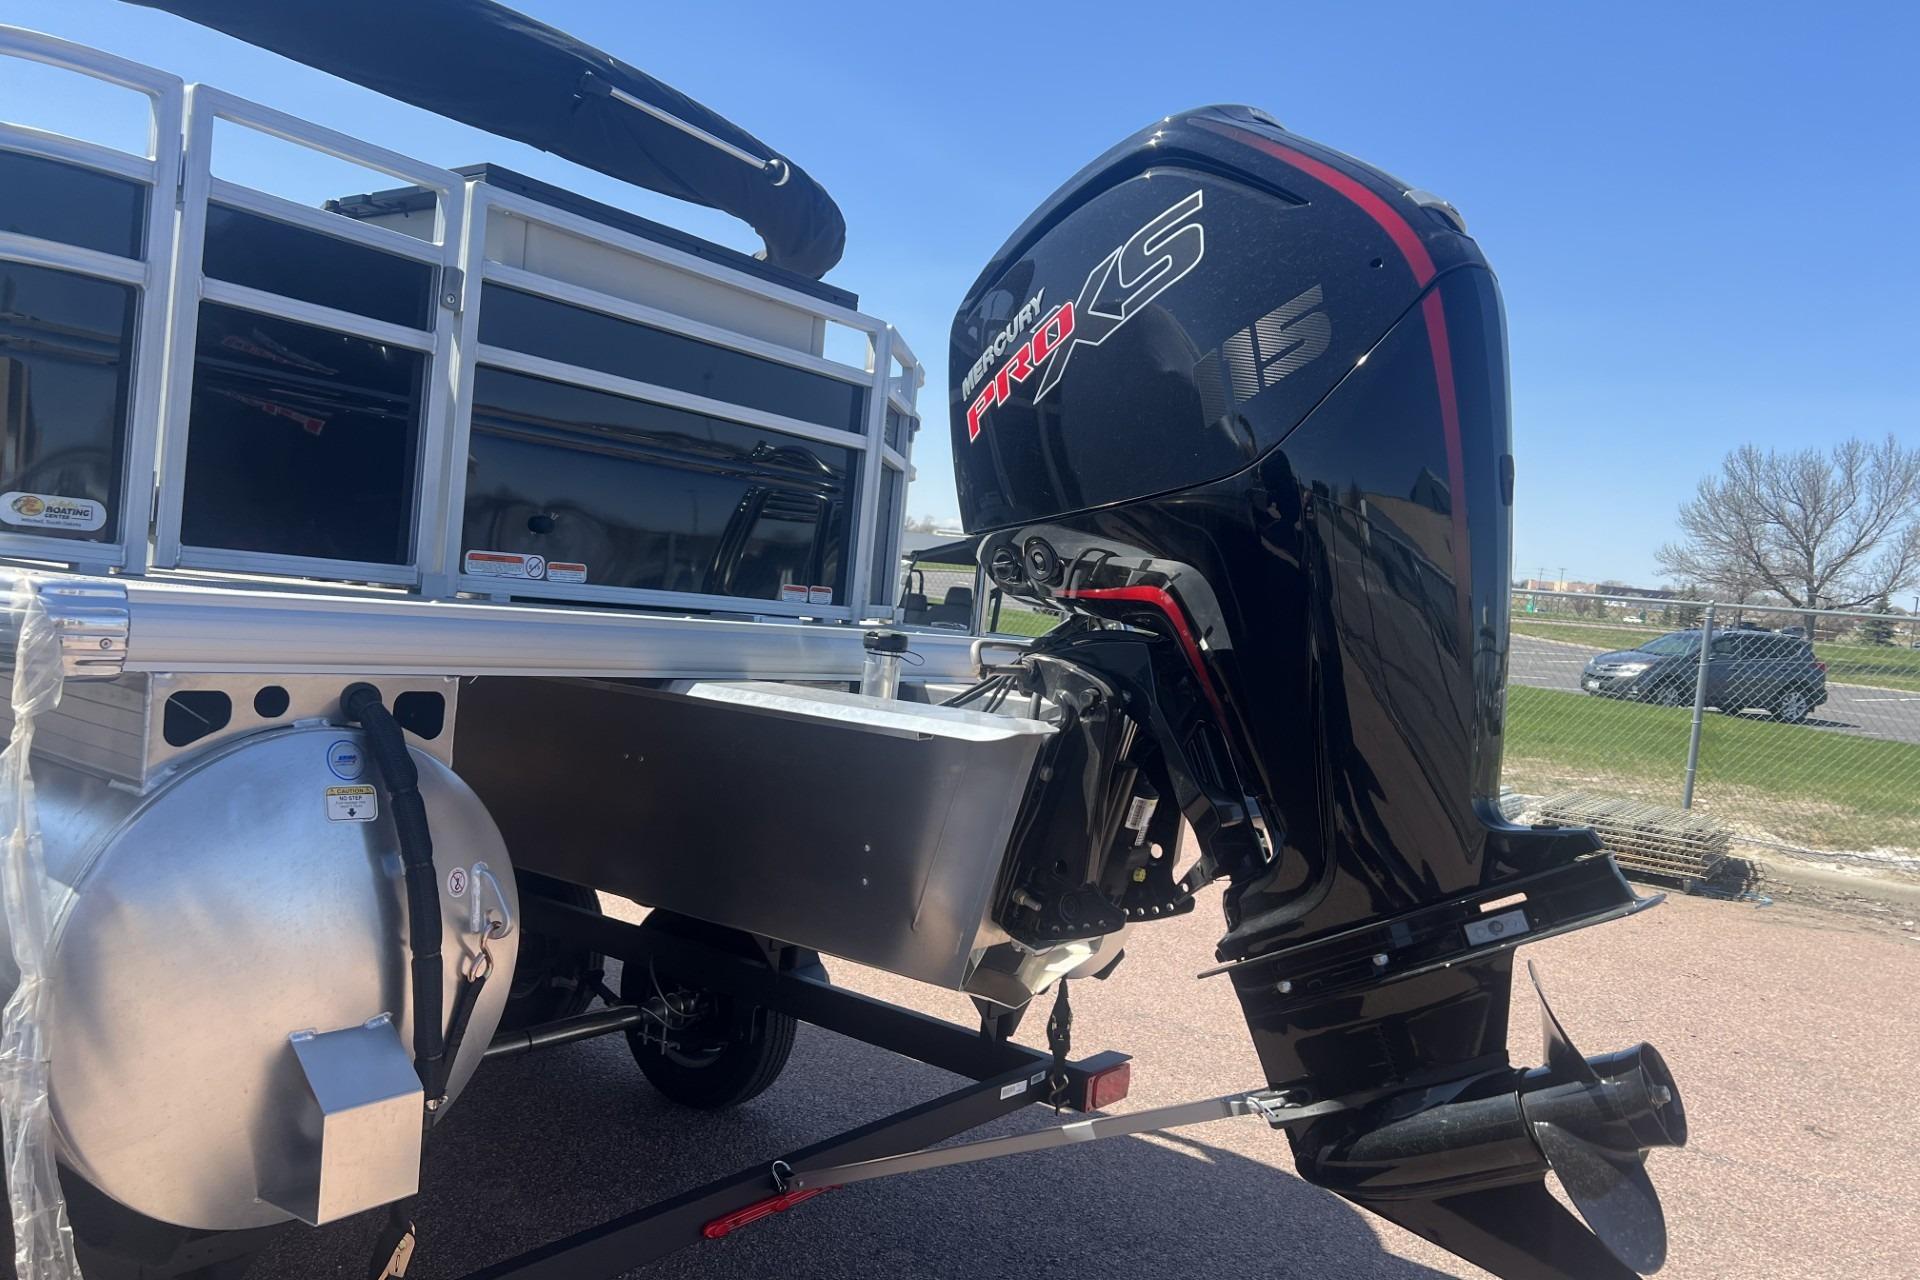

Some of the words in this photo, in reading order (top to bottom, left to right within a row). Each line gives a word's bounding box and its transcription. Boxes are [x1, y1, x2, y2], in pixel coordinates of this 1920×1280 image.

[961, 287, 1045, 401] MERCURY
[966, 301, 1076, 444] PRO
[1031, 188, 1205, 405] XS
[1192, 283, 1332, 429] 115
[45, 505, 90, 517] BOATING
